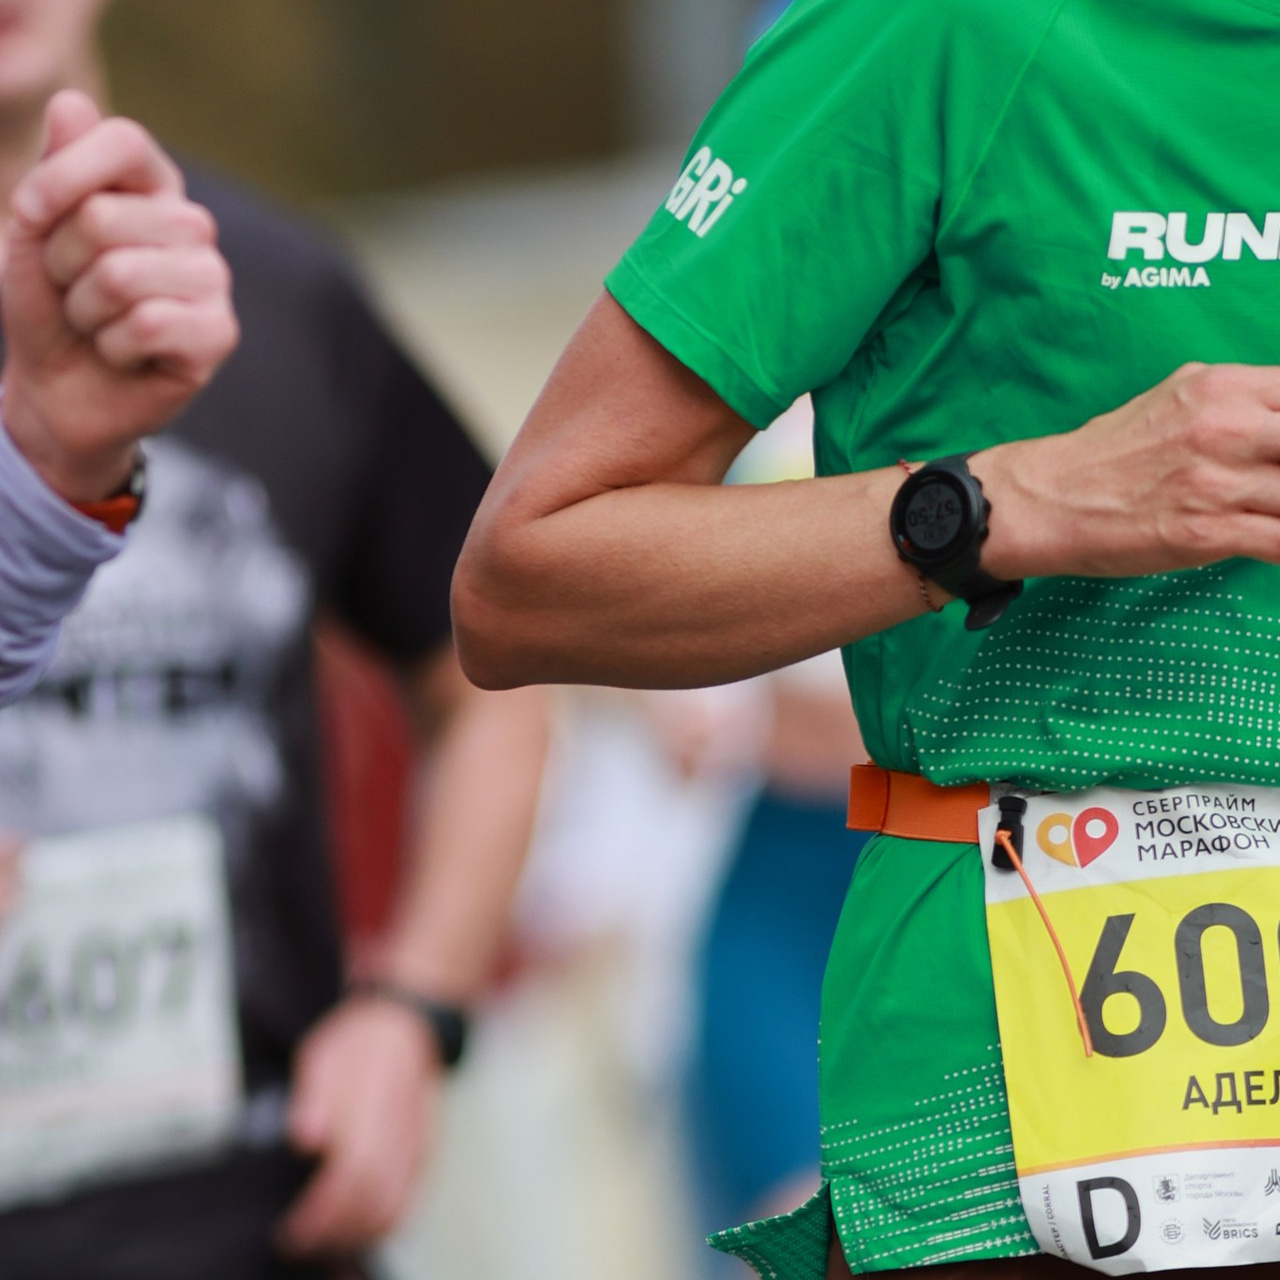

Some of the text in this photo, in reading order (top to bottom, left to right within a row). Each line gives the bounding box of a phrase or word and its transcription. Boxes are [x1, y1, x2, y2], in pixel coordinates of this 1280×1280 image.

[665, 146, 748, 238] GRi
[1100, 267, 1211, 290] by AGIMA
[1132, 794, 1256, 816] СБЕРПРАЙМ
[1138, 834, 1271, 862] МАРАФОН
[1042, 1183, 1054, 1220] CORRAL
[1076, 1176, 1142, 1261] D
[1223, 1228, 1259, 1240] BRICS
